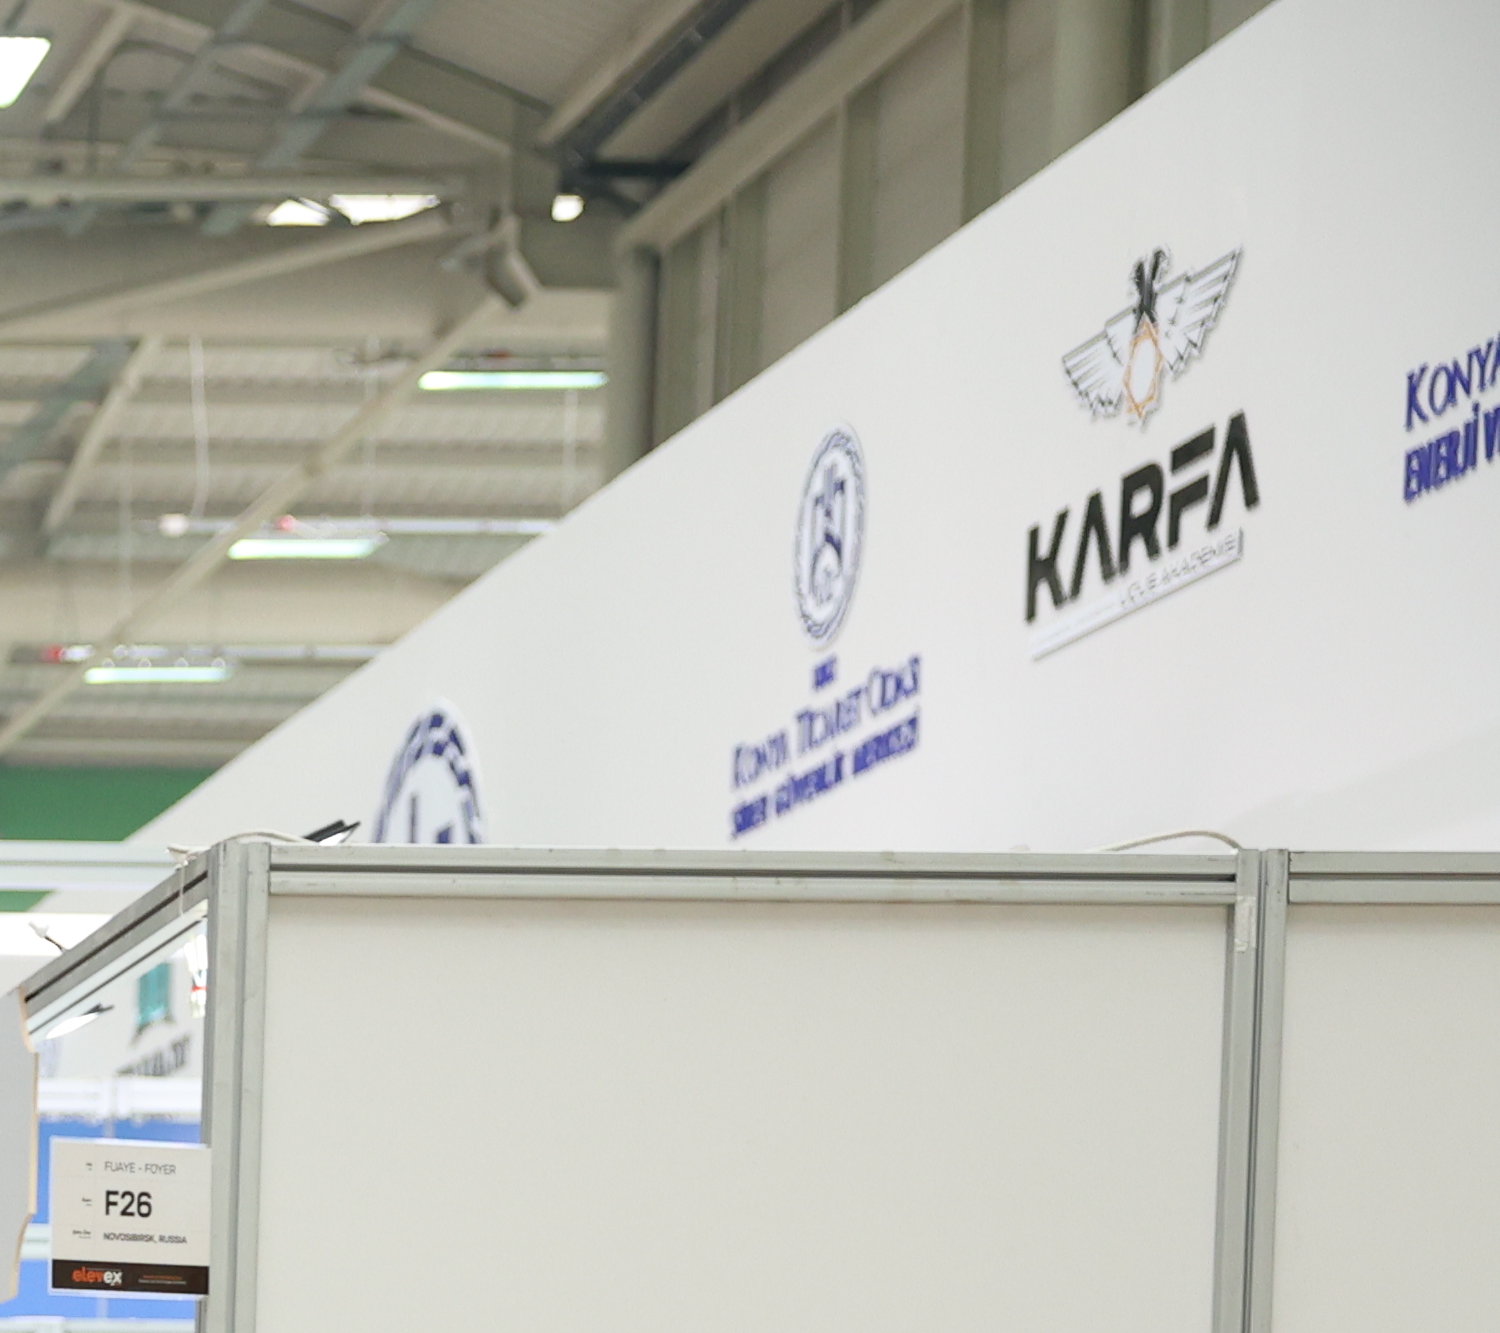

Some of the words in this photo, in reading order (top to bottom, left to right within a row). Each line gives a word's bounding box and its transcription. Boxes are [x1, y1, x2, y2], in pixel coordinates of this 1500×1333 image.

[1024, 409, 1261, 624] KARFA
[104, 1161, 135, 1174] FUAYE
[144, 1163, 177, 1175] FOYER
[105, 1190, 152, 1218] F26
